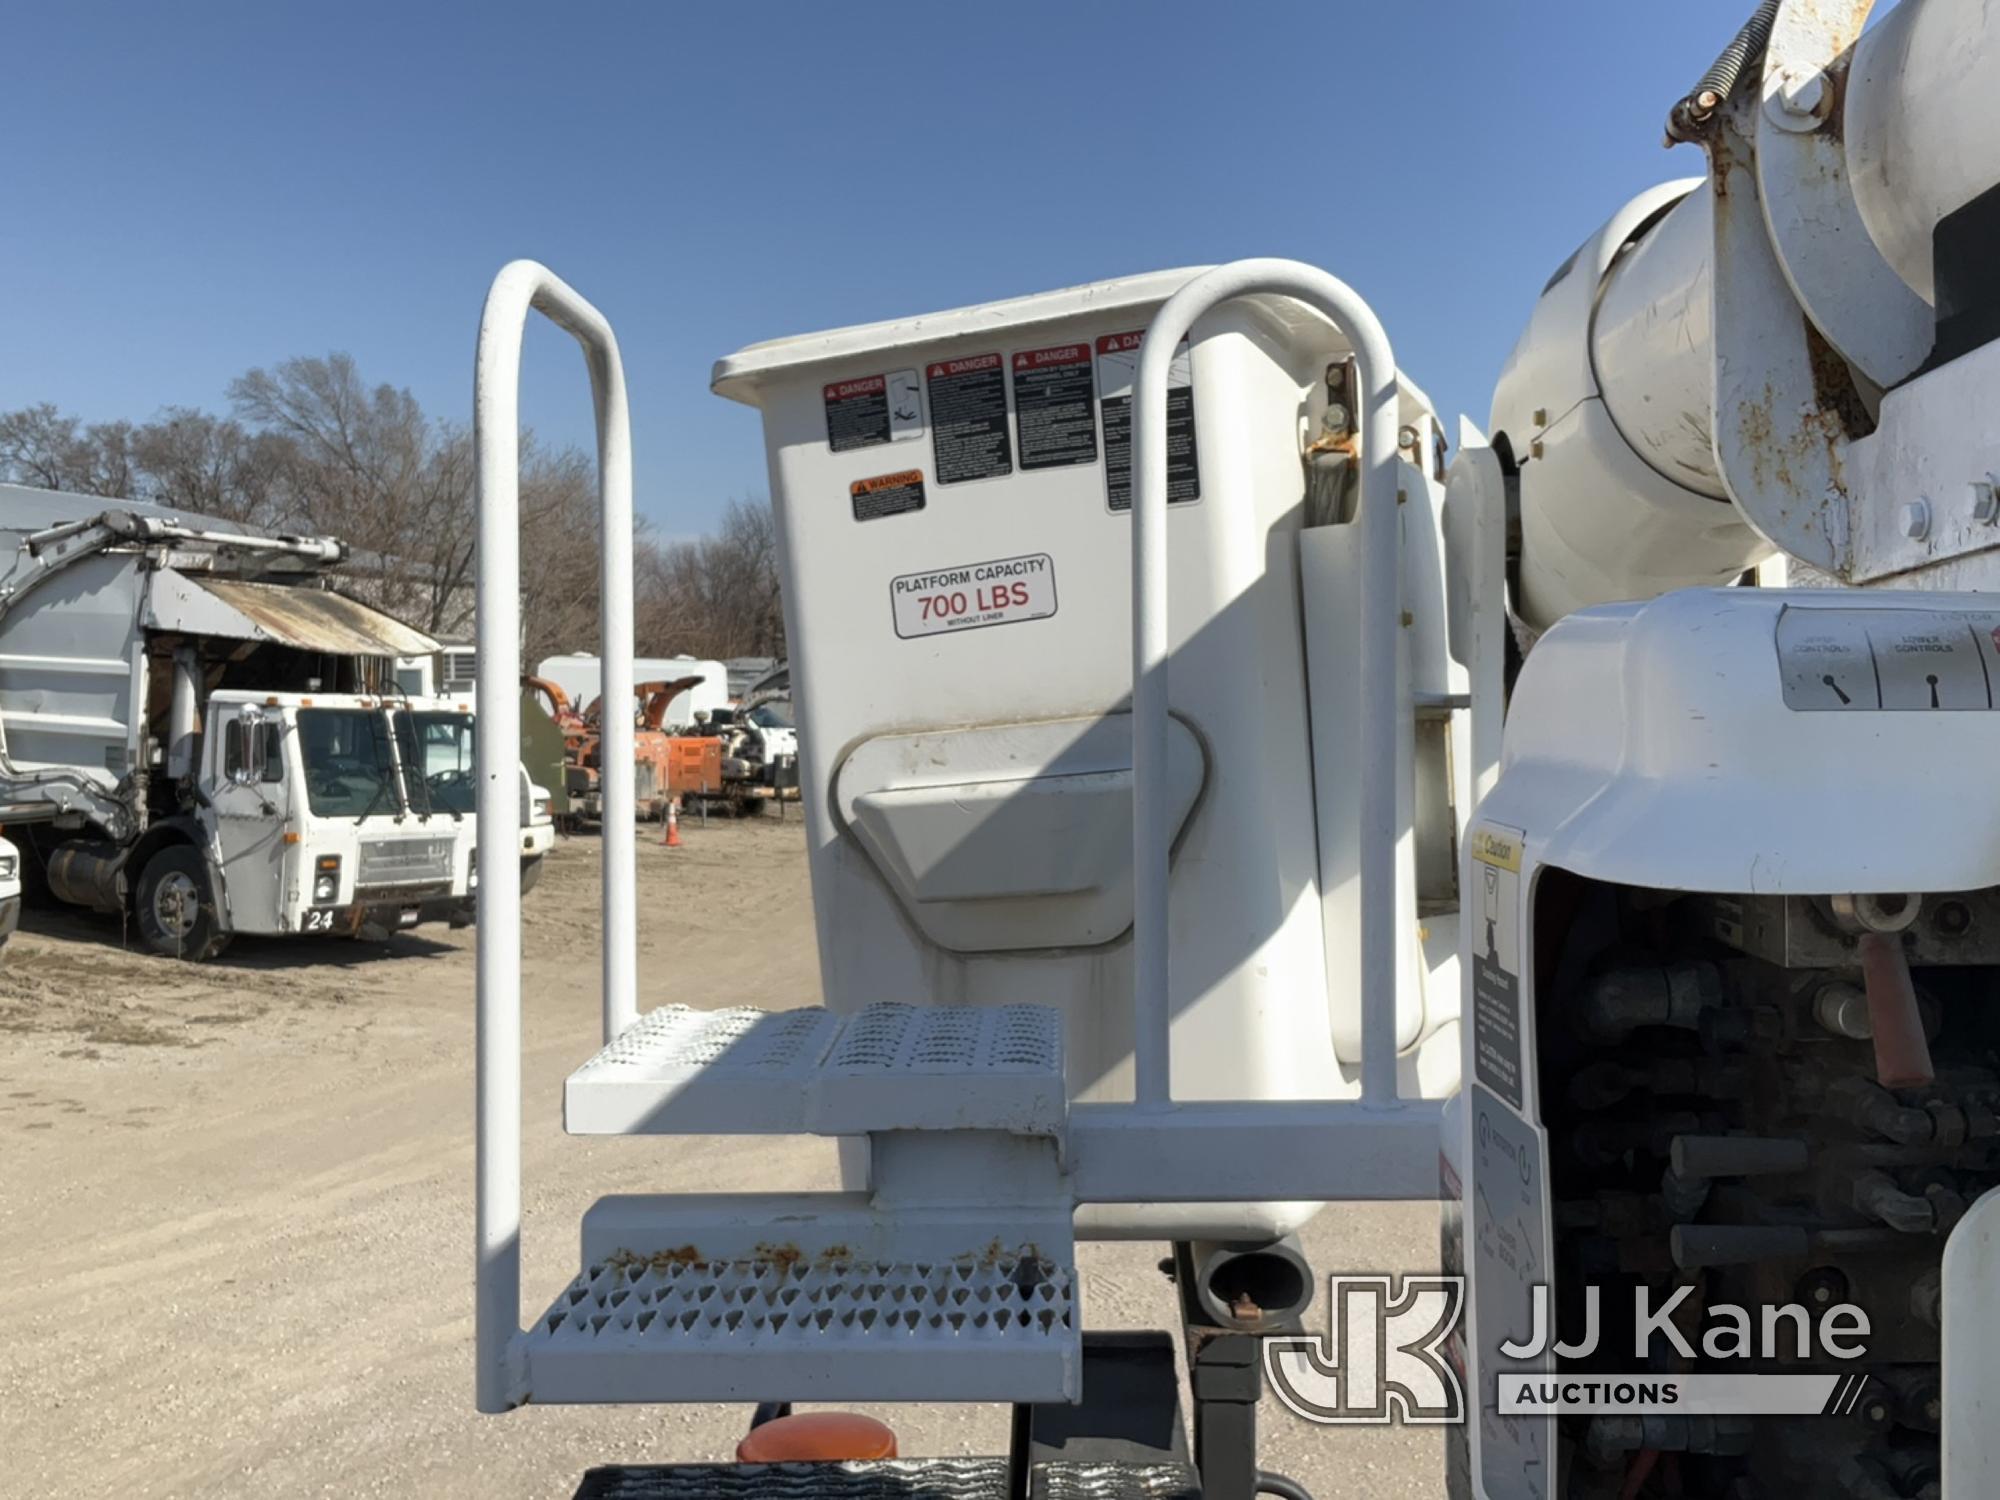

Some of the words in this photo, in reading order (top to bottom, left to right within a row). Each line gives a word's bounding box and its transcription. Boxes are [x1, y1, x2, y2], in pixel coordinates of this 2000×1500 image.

[949, 356, 998, 373] DANGER
[1035, 348, 1079, 364] DANGER
[839, 379, 883, 396] DANGER
[866, 471, 919, 489] WARNING
[896, 571, 971, 593] PLATFORM
[975, 558, 1046, 581] CAPACITY
[918, 592, 967, 620] 700
[976, 582, 1029, 611] LBS
[947, 615, 981, 626] WITHOUT
[982, 612, 1004, 621] LINER
[1894, 644, 1954, 653] CONTROLS
[1484, 834, 1512, 860] Caution
[308, 911, 334, 930] 24
